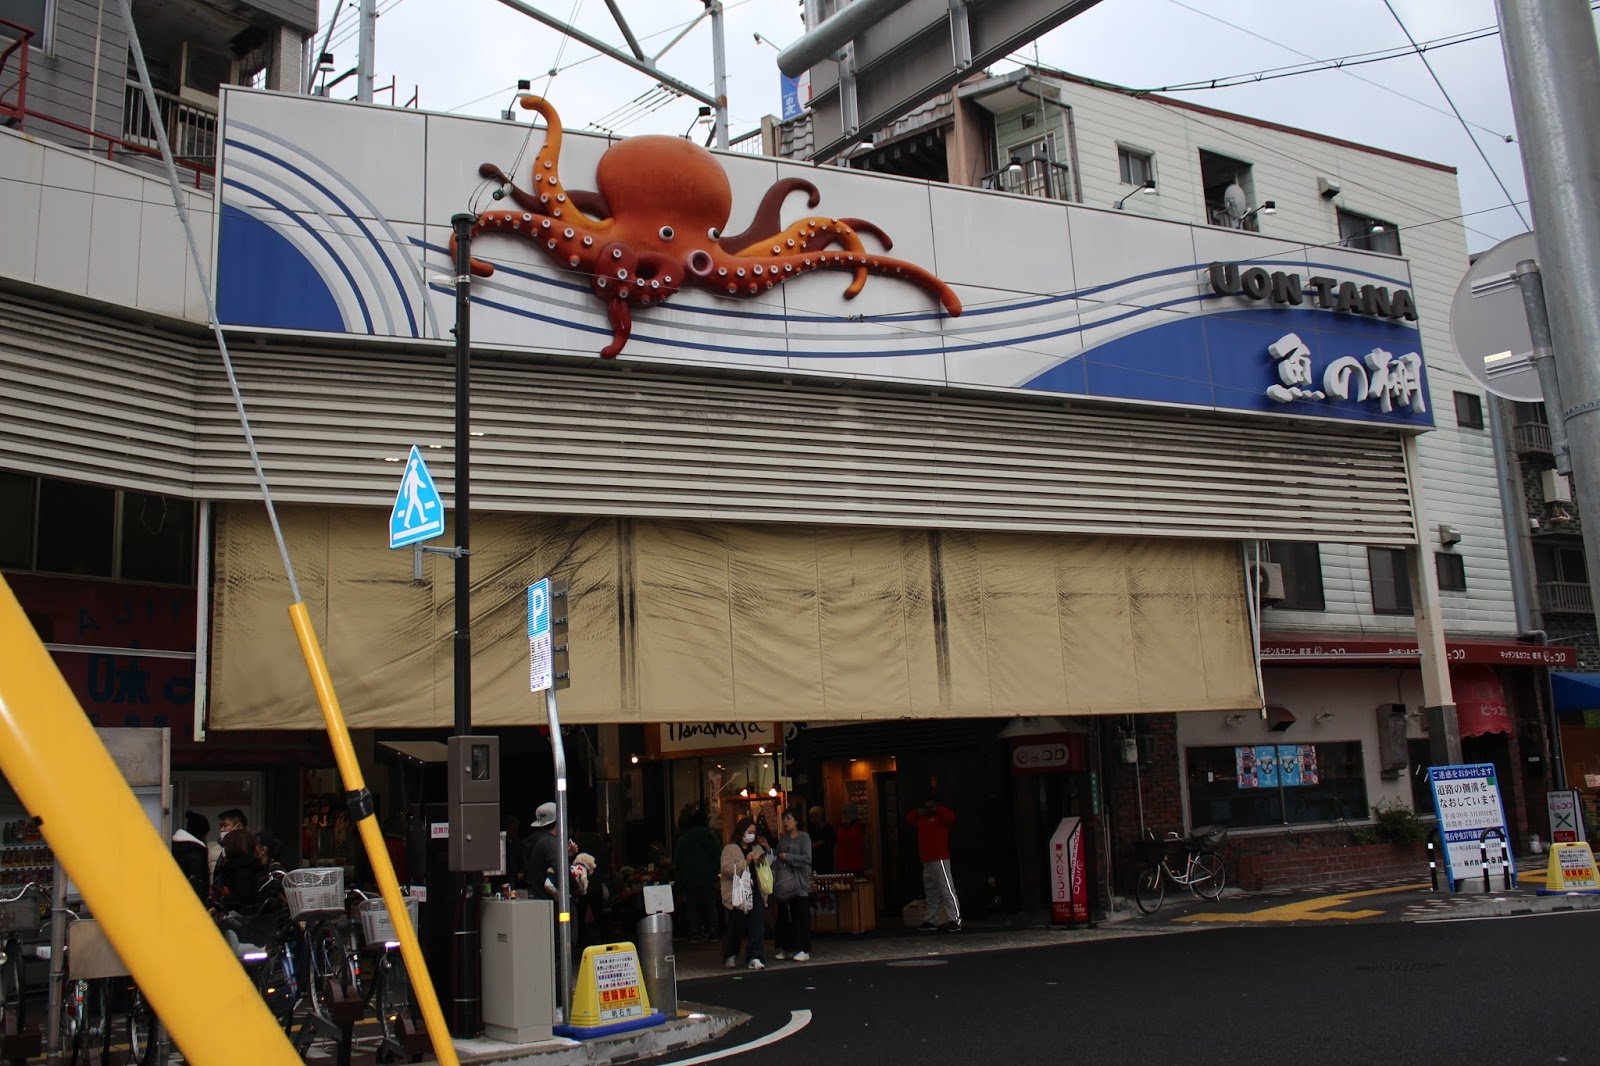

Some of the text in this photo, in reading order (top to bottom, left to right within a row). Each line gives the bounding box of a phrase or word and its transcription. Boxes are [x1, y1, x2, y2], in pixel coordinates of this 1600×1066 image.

[1209, 261, 1418, 321] UON TANA
[1266, 332, 1426, 414] 魚の棚
[532, 587, 545, 631] P
[1432, 767, 1493, 779] ご迷惑をおかけします
[1437, 781, 1488, 795] 道路の側溝を
[1439, 793, 1497, 808] なおしています
